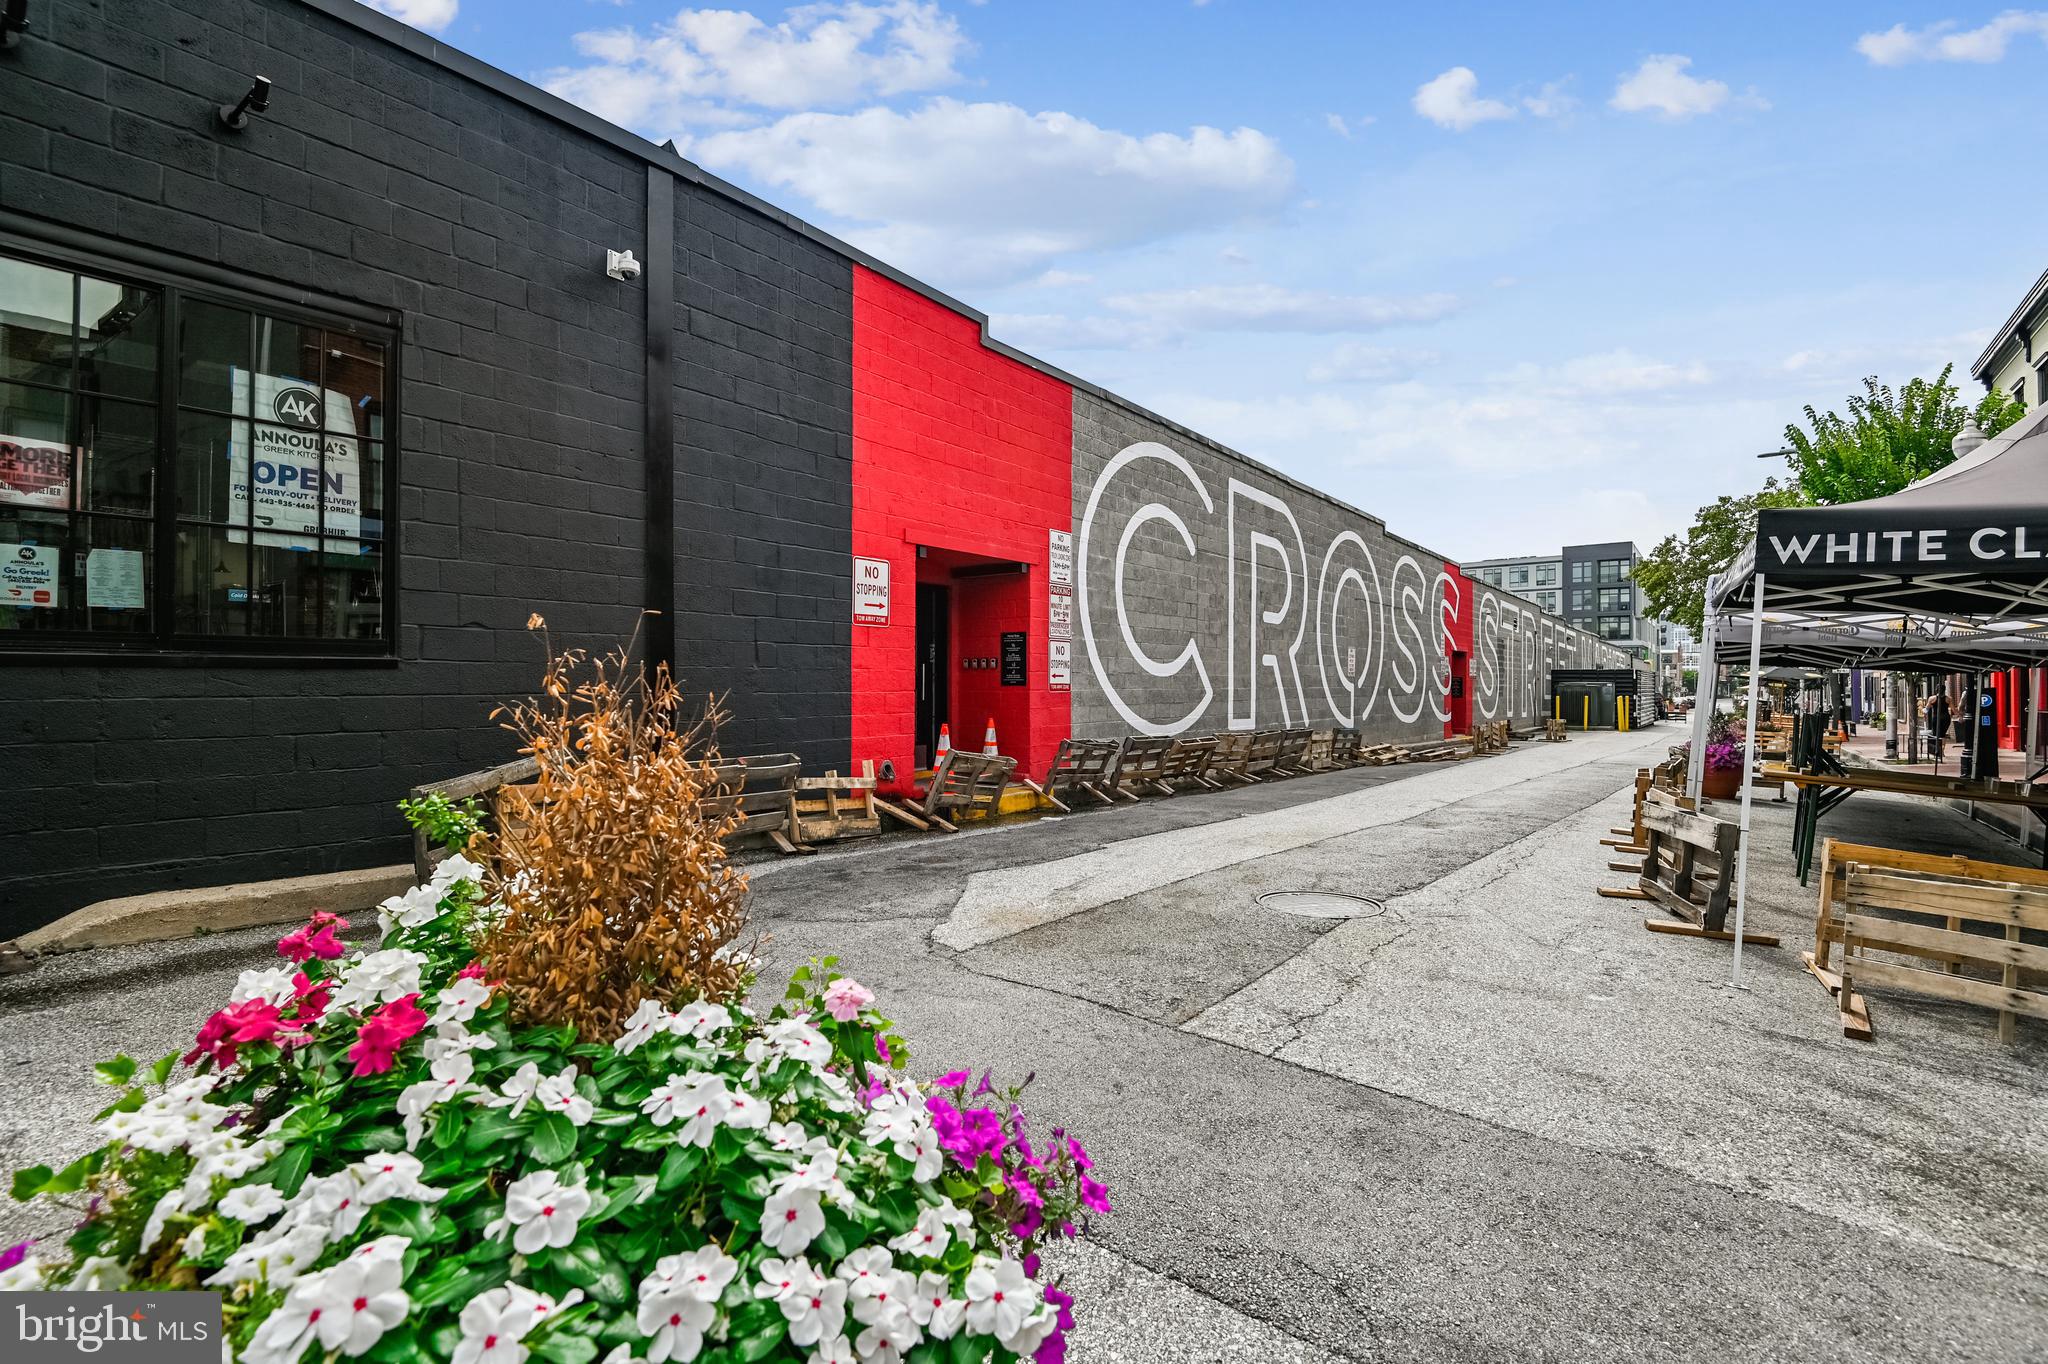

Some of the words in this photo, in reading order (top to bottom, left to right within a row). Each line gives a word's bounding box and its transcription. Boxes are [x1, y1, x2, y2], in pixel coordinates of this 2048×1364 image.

[280, 394, 317, 425] AK
[263, 445, 295, 456] GREEK
[253, 461, 343, 494] OPEN
[255, 486, 309, 501] CARRY-OUT
[1768, 529, 1948, 565] WHITE
[1968, 526, 2048, 560] CL
[4, 566, 17, 574] Go
[864, 565, 879, 579] NO
[856, 583, 887, 598] STOPPING
[1078, 441, 1460, 738] CROSS
[1055, 645, 1065, 656] NO
[1051, 659, 1070, 669] STOPPING
